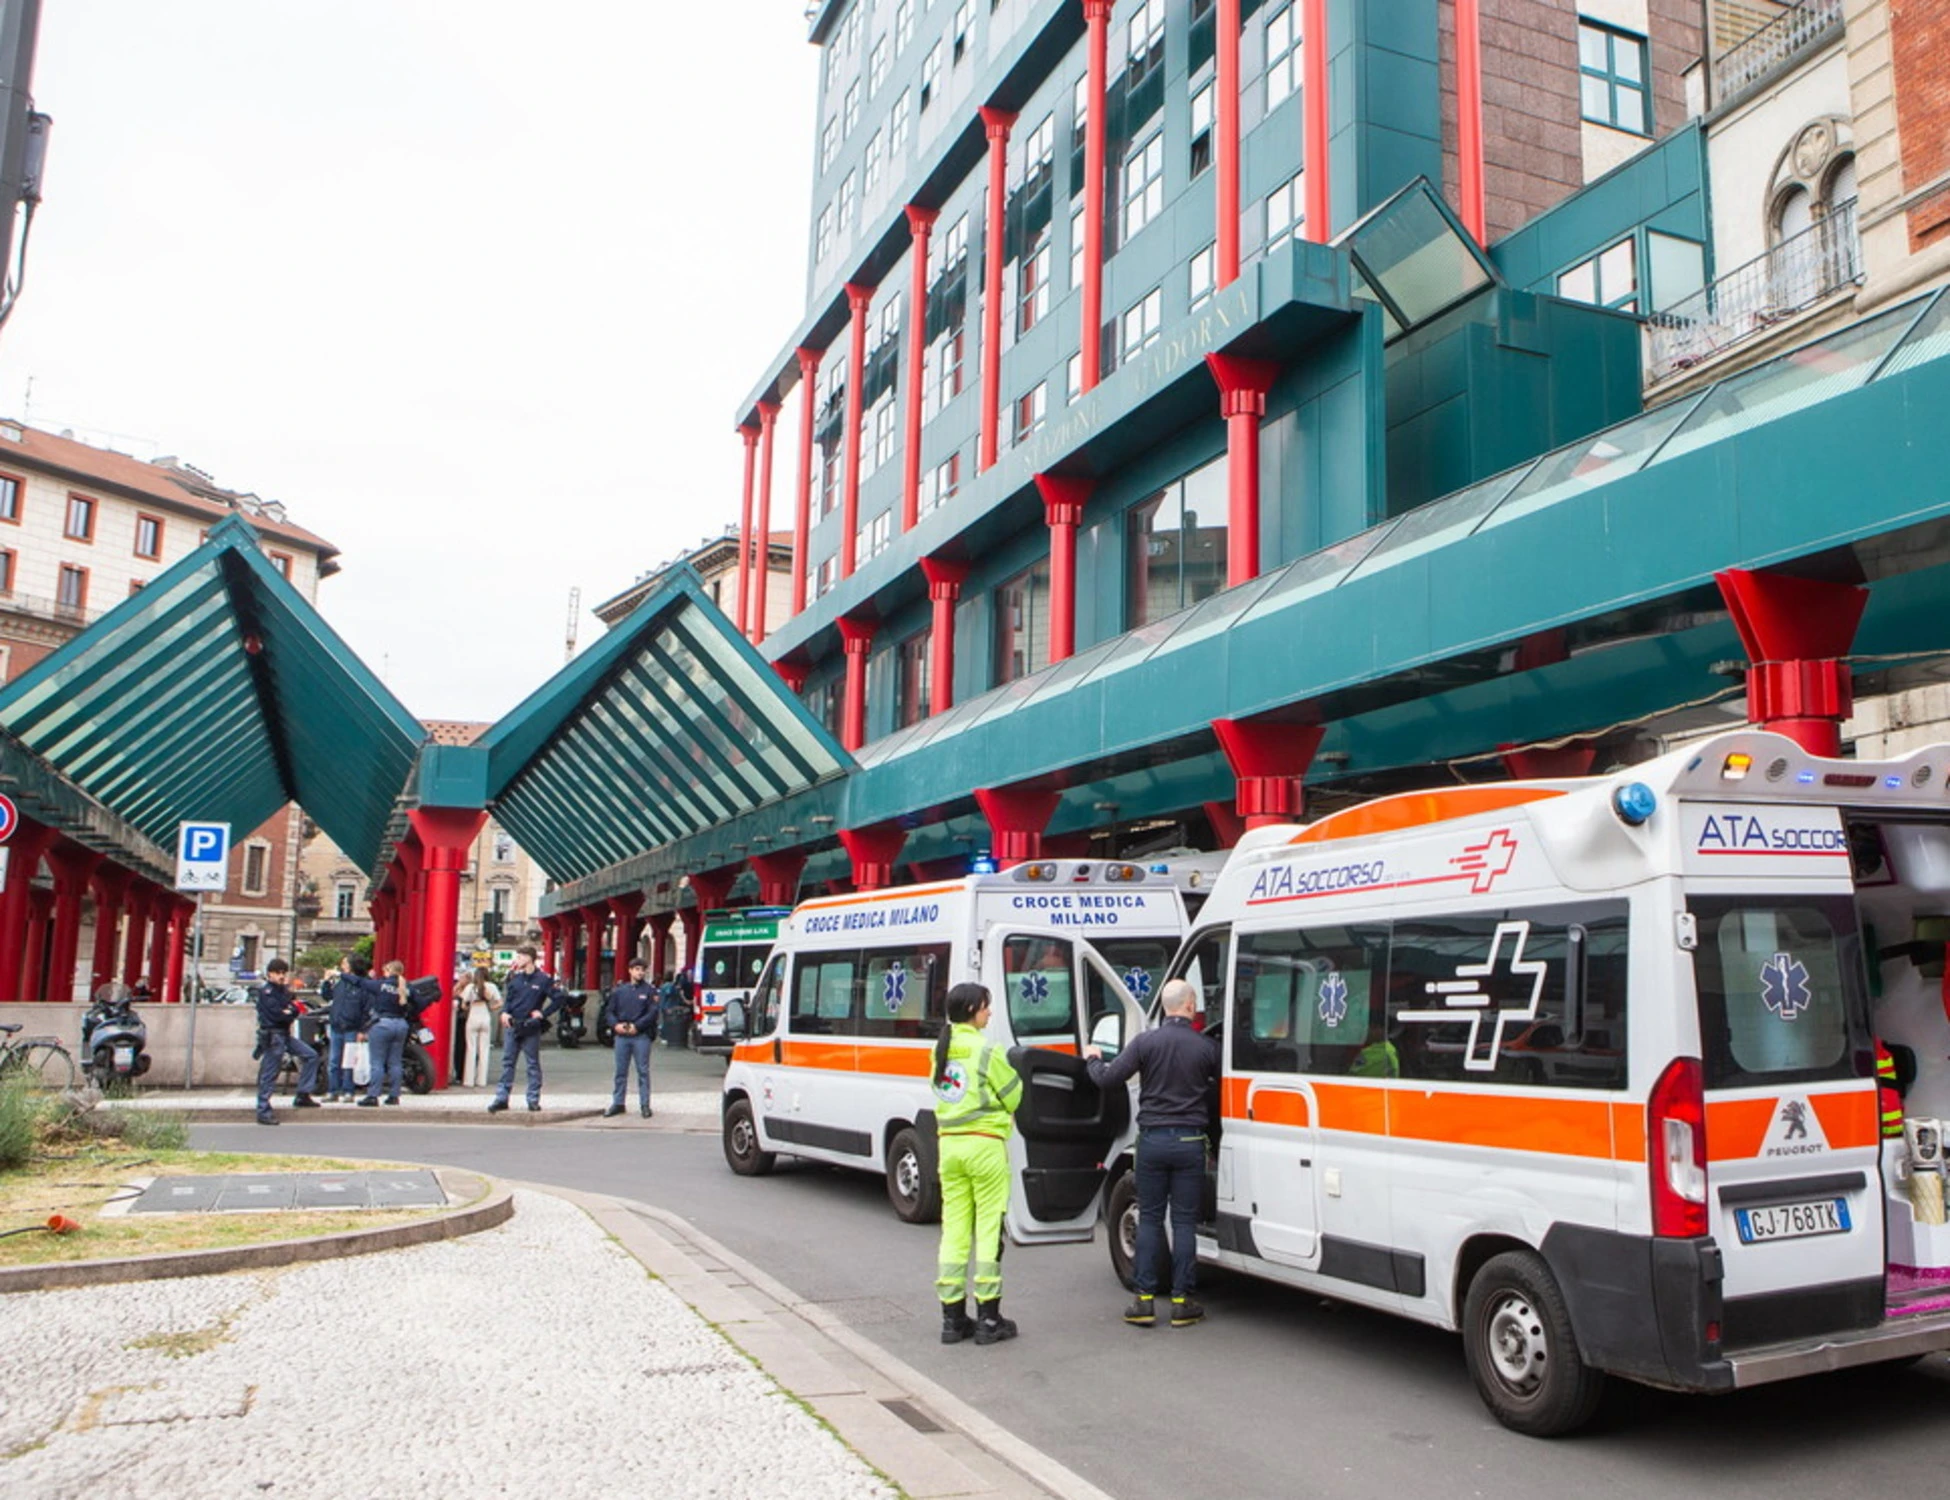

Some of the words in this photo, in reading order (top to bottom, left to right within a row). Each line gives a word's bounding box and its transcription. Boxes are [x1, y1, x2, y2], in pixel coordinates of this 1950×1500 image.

[1134, 291, 1248, 393] CADORNA
[191, 830, 217, 858] P
[1698, 815, 1769, 847] ATA
[1250, 865, 1293, 898] ATA
[1296, 861, 1384, 894] SOCCORSO
[1012, 896, 1073, 908] CROCE
[1080, 896, 1146, 908] MEDICA
[805, 914, 841, 934] CROCE
[842, 910, 886, 931] MEDICA
[889, 904, 939, 926] MILANO
[1051, 912, 1119, 925] MILANO
[1767, 1144, 1823, 1157] PEUGEOT
